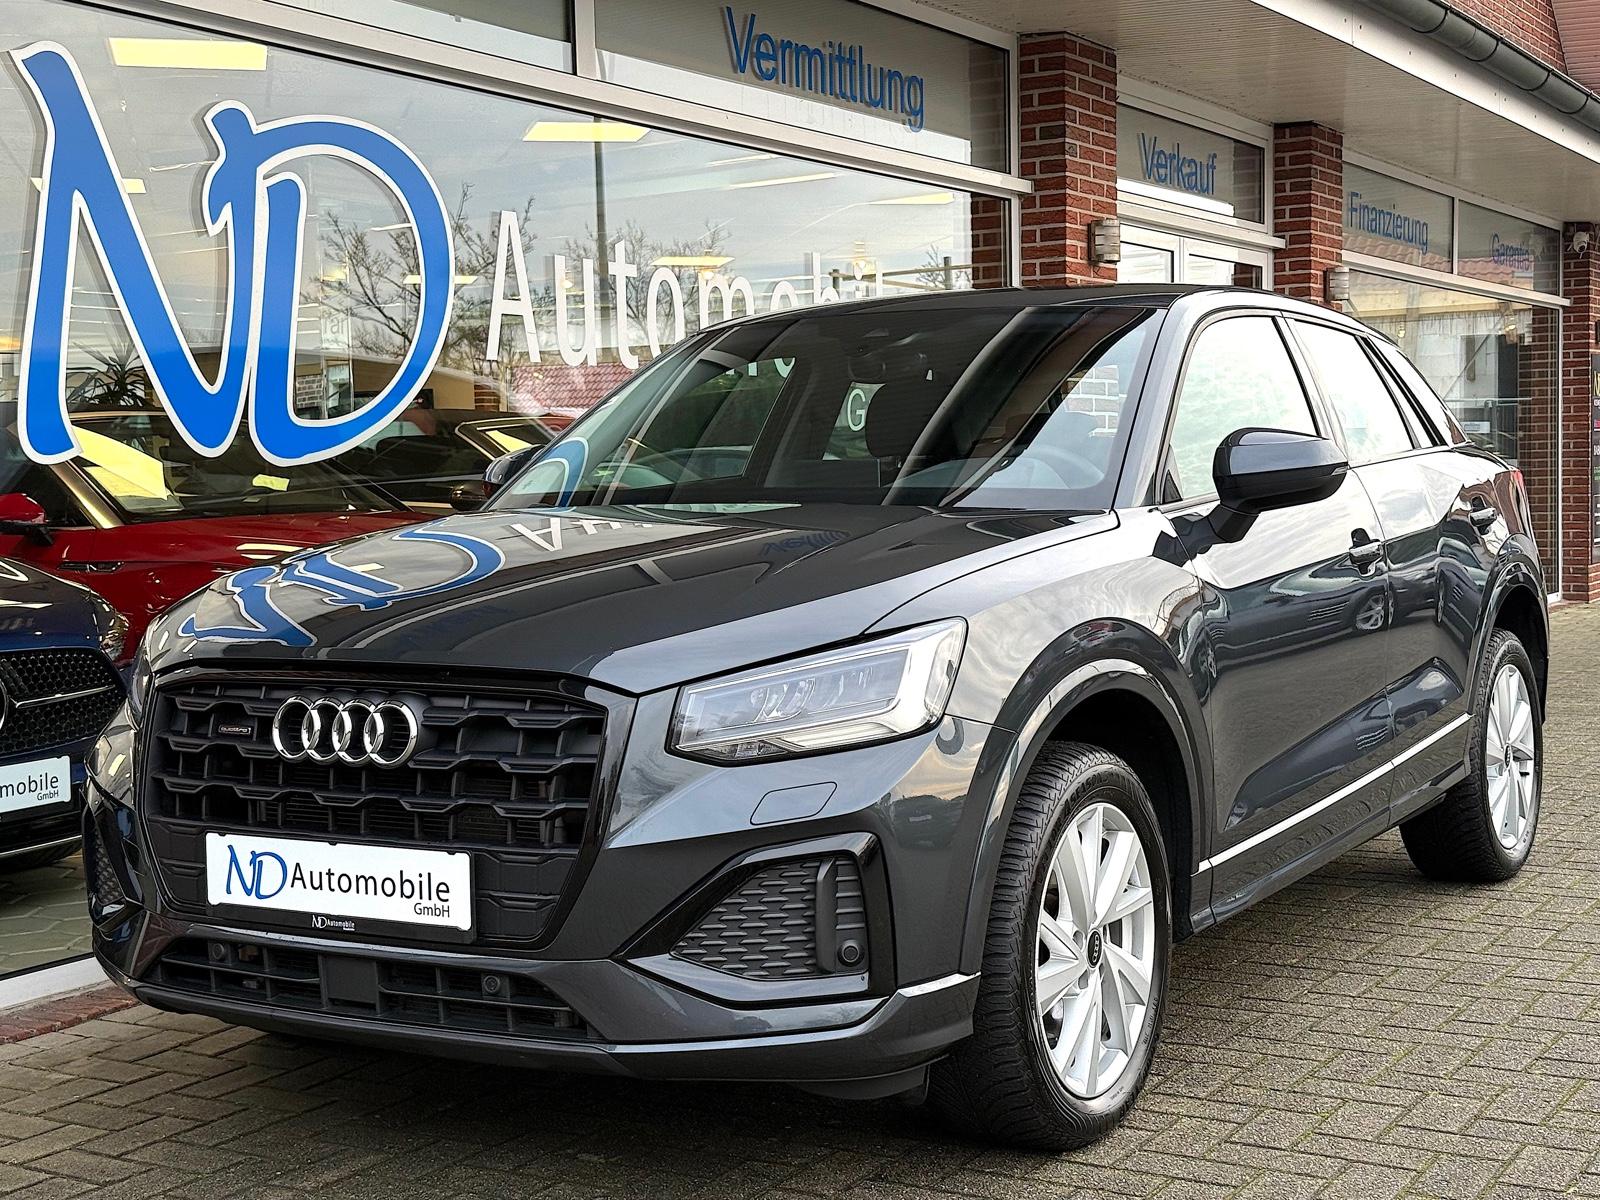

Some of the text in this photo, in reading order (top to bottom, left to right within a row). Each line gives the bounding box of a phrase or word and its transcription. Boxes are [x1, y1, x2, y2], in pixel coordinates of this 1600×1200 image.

[725, 6, 925, 133] Vermittlung
[1141, 132, 1217, 196] Verkauf
[1349, 191, 1429, 255] Finanzierung
[8, 41, 456, 467] ND
[0, 772, 59, 799] mobile
[36, 790, 59, 801] GmbH
[225, 844, 451, 903] ND Automobile
[413, 902, 451, 918] GmbH
